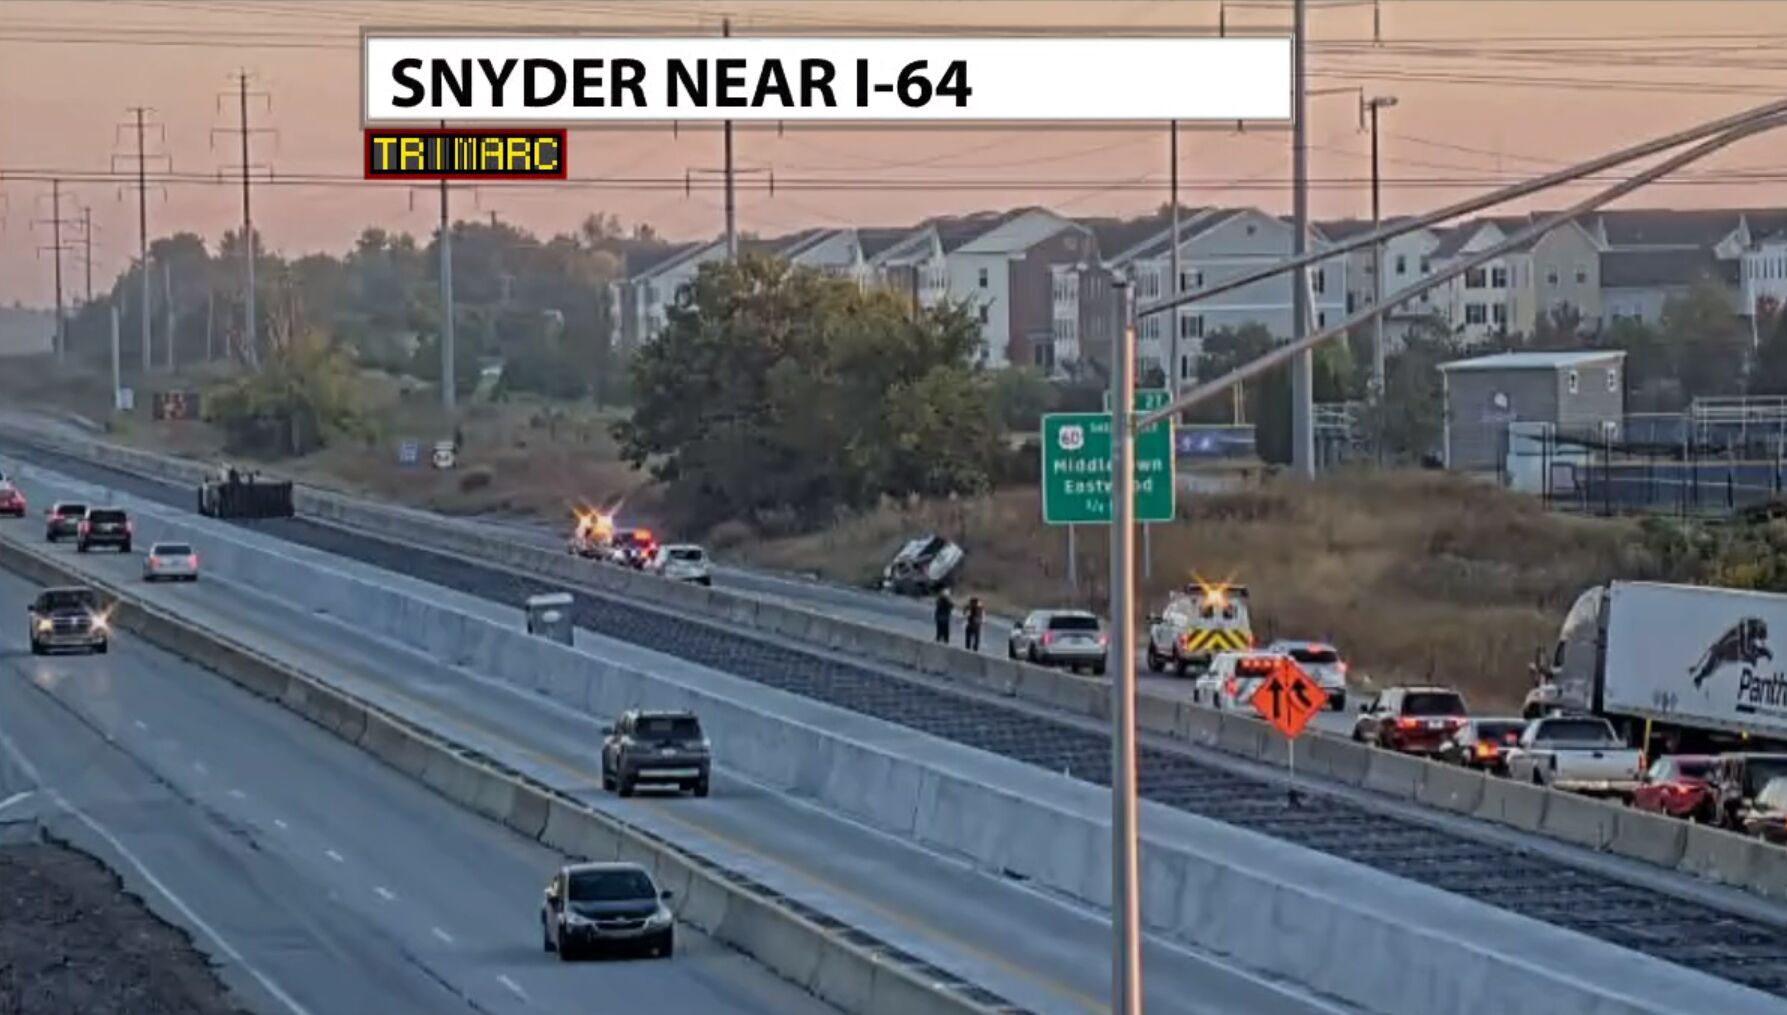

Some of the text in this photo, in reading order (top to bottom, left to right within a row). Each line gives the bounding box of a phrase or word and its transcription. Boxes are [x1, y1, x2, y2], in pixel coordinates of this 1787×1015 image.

[1062, 430, 1081, 446] 60
[1054, 456, 1162, 474] Middlewn
[1064, 477, 1153, 495] Eastwod
